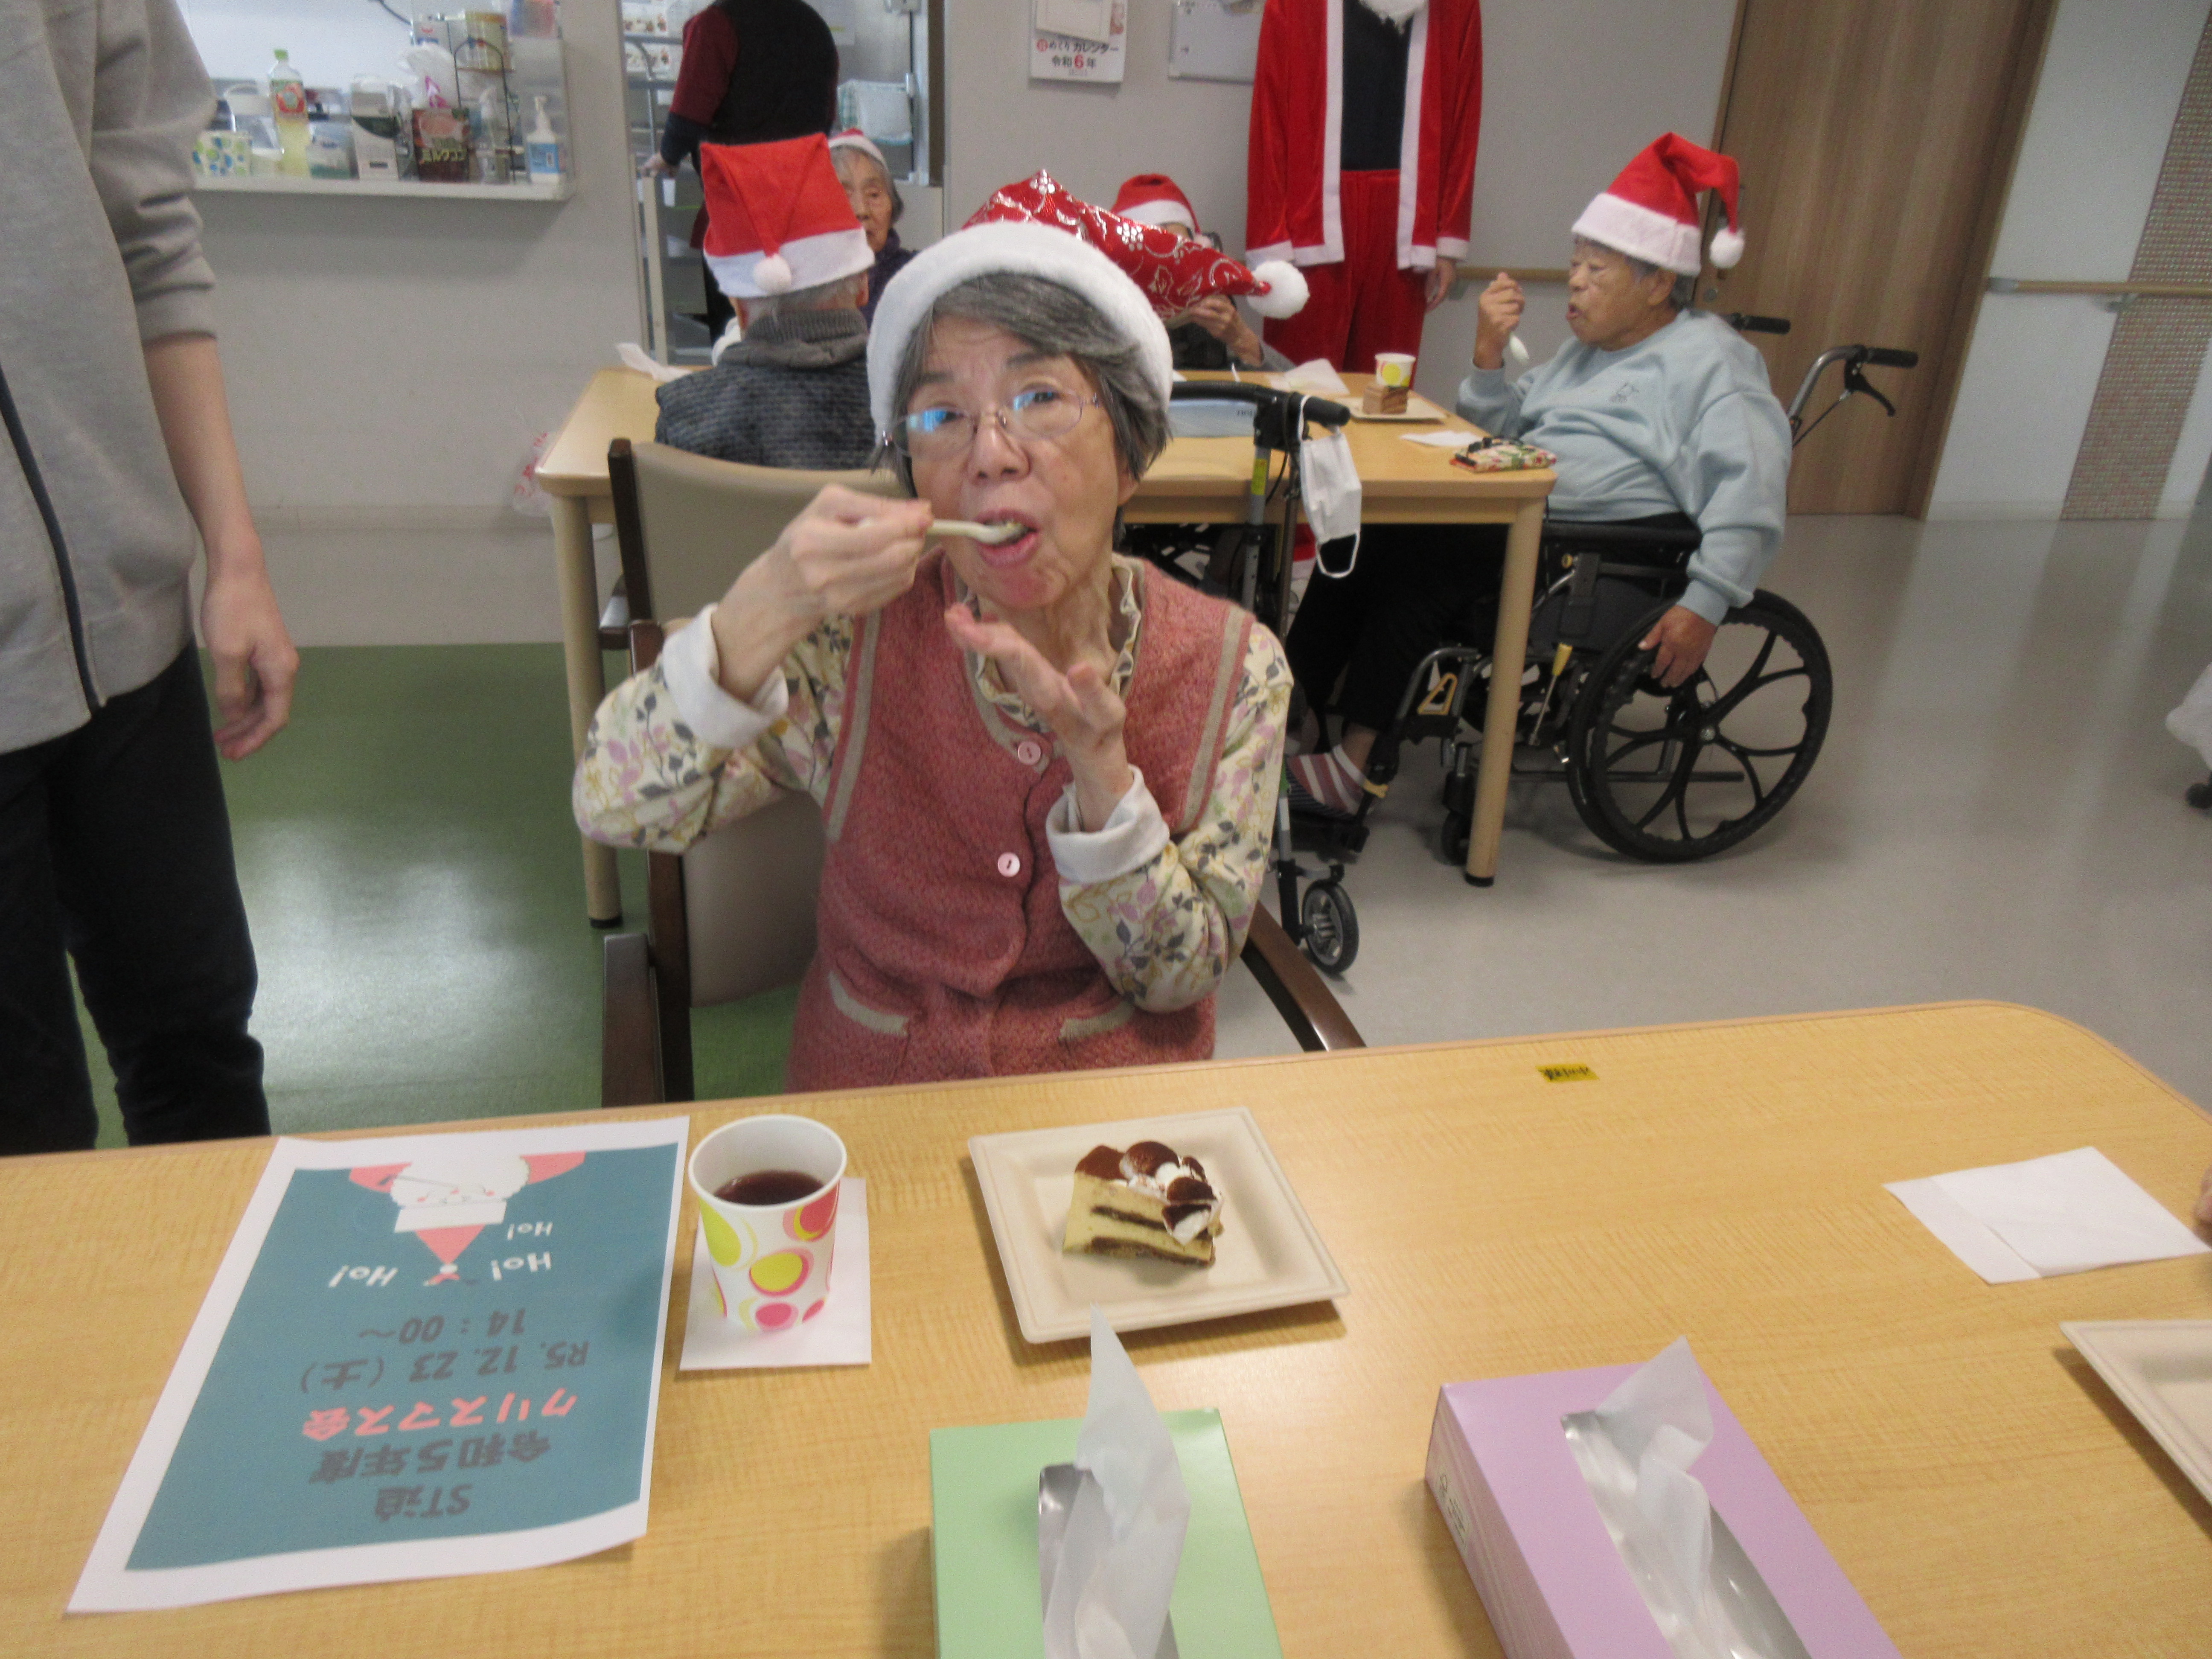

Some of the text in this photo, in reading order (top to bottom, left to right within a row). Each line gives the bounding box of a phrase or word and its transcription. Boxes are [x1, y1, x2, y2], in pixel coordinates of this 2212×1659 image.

[1052, 54, 1096, 69] 令和6年
[507, 1222, 553, 1240] Ho!
[328, 1265, 398, 1288] Ho!
[491, 1251, 552, 1281] Ho!
[302, 1388, 577, 1441] クリスマス会
[309, 1429, 551, 1484] 令和5年度
